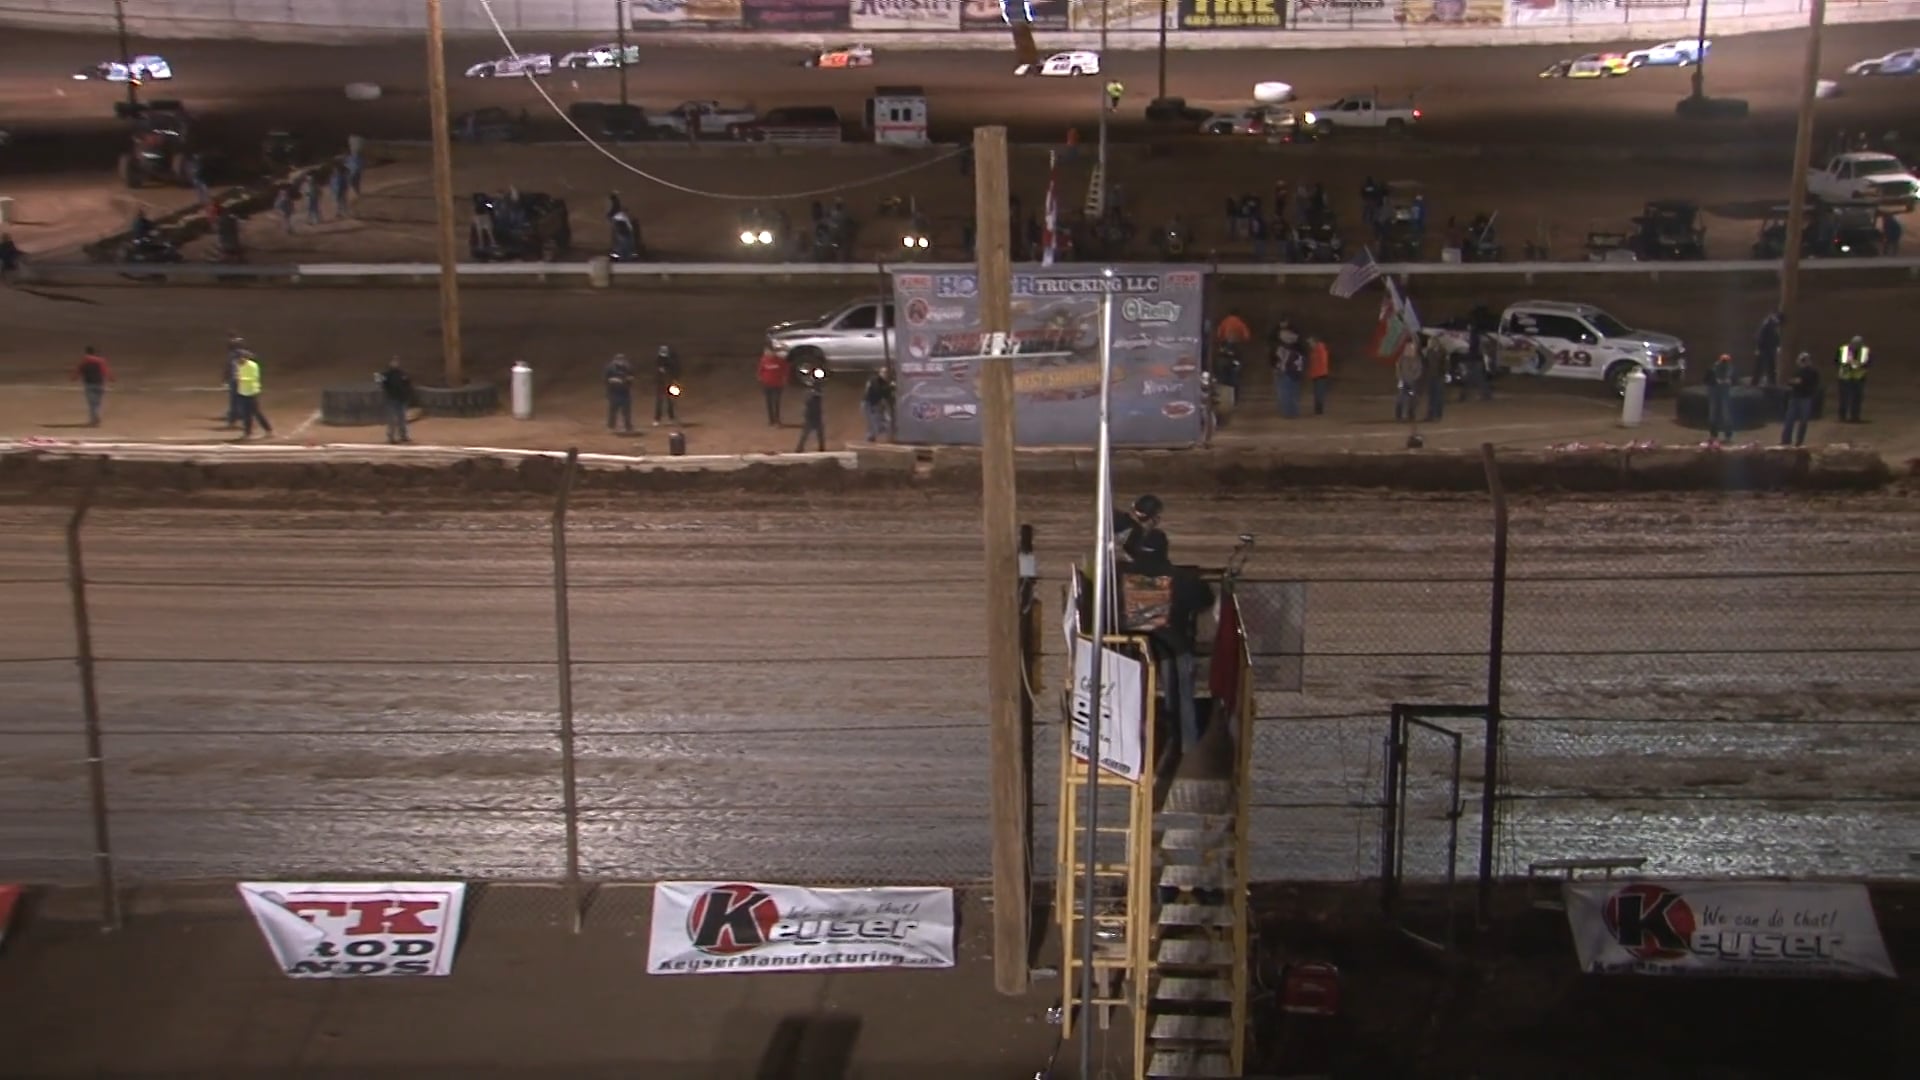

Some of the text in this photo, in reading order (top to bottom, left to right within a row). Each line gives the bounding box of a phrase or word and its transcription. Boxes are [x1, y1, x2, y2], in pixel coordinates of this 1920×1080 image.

[1036, 278, 1121, 292] TRUCKING
[1127, 277, 1159, 291] LLC
[1553, 349, 1592, 367] 49
